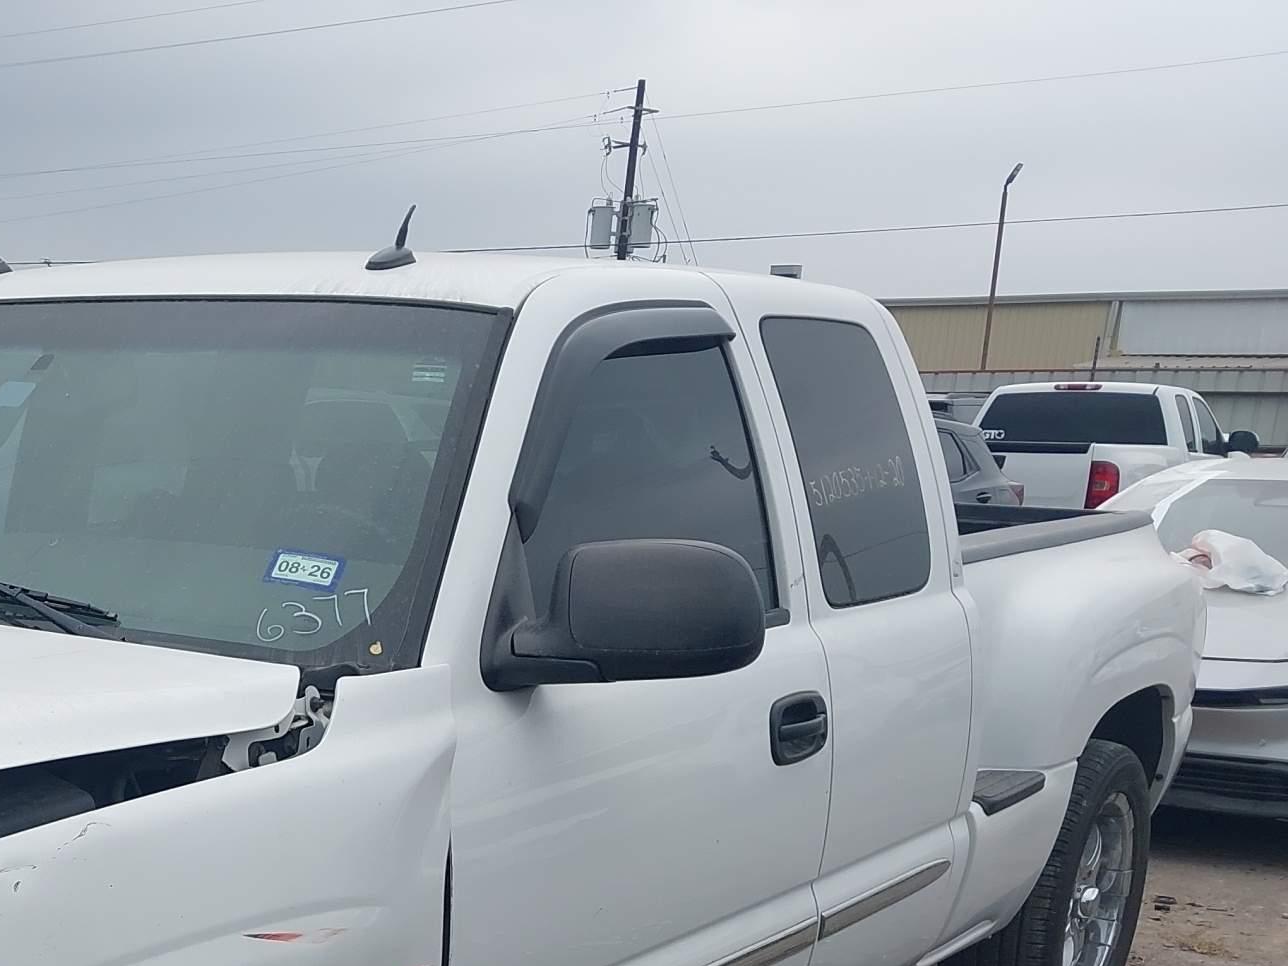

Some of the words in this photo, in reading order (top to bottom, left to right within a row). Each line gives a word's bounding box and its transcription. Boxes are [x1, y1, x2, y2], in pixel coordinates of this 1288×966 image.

[277, 560, 301, 574] 08
[308, 564, 333, 580] 26
[256, 588, 372, 642] 6377
